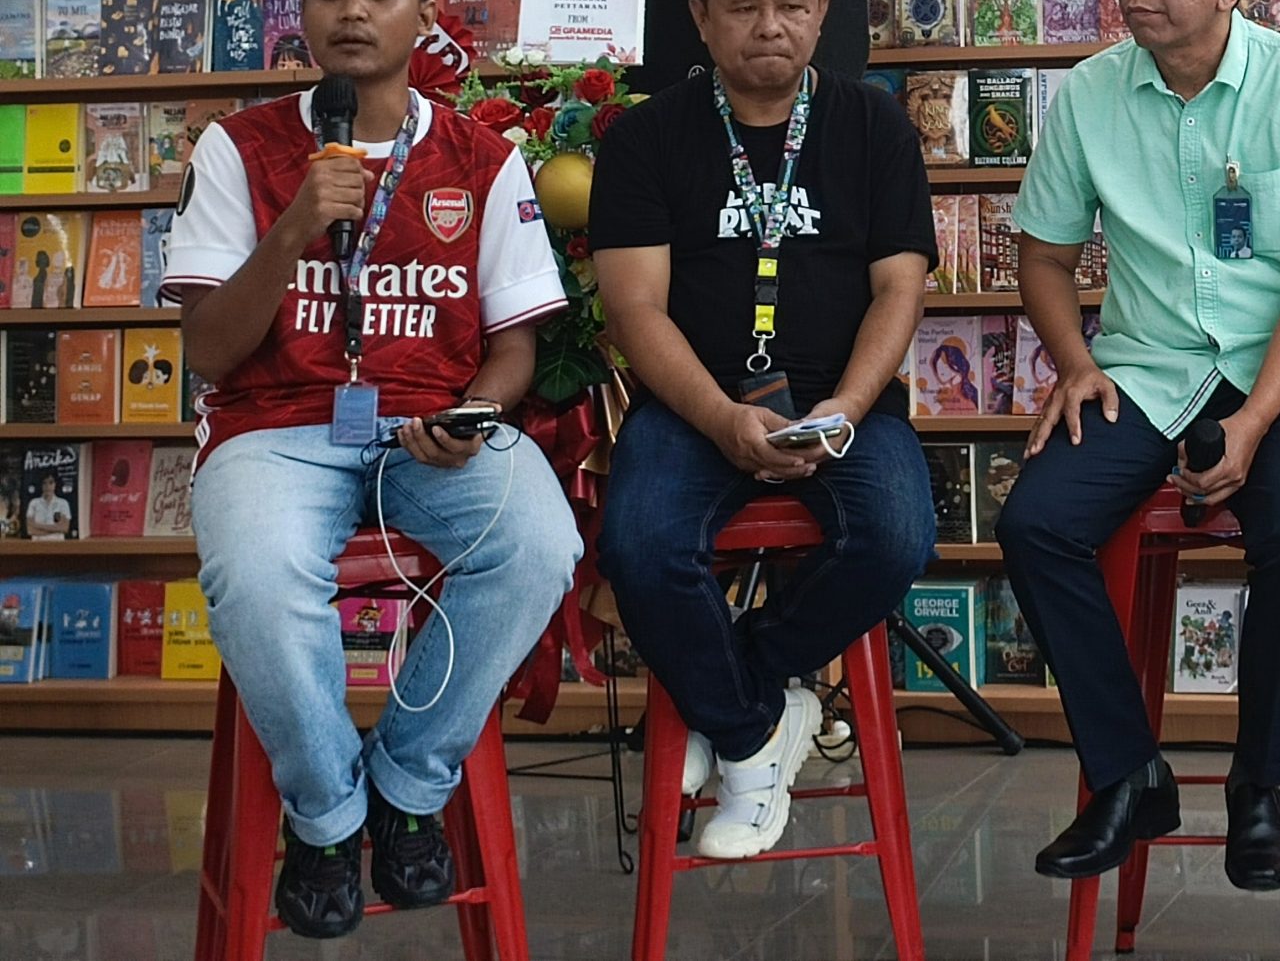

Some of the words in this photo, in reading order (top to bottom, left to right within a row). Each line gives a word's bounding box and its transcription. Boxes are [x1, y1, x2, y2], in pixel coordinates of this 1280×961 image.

[554, 2, 608, 10] PETTARANI
[567, 14, 589, 24] FROM
[563, 26, 613, 36] GRAMEDIA
[431, 196, 466, 208] Arsenal
[288, 257, 469, 299] mrates
[295, 298, 336, 335] FLY
[362, 302, 437, 339] ETTER
[70, 392, 102, 403] GENAP
[914, 598, 960, 608] GEORGE
[914, 607, 960, 618] ORWELL
